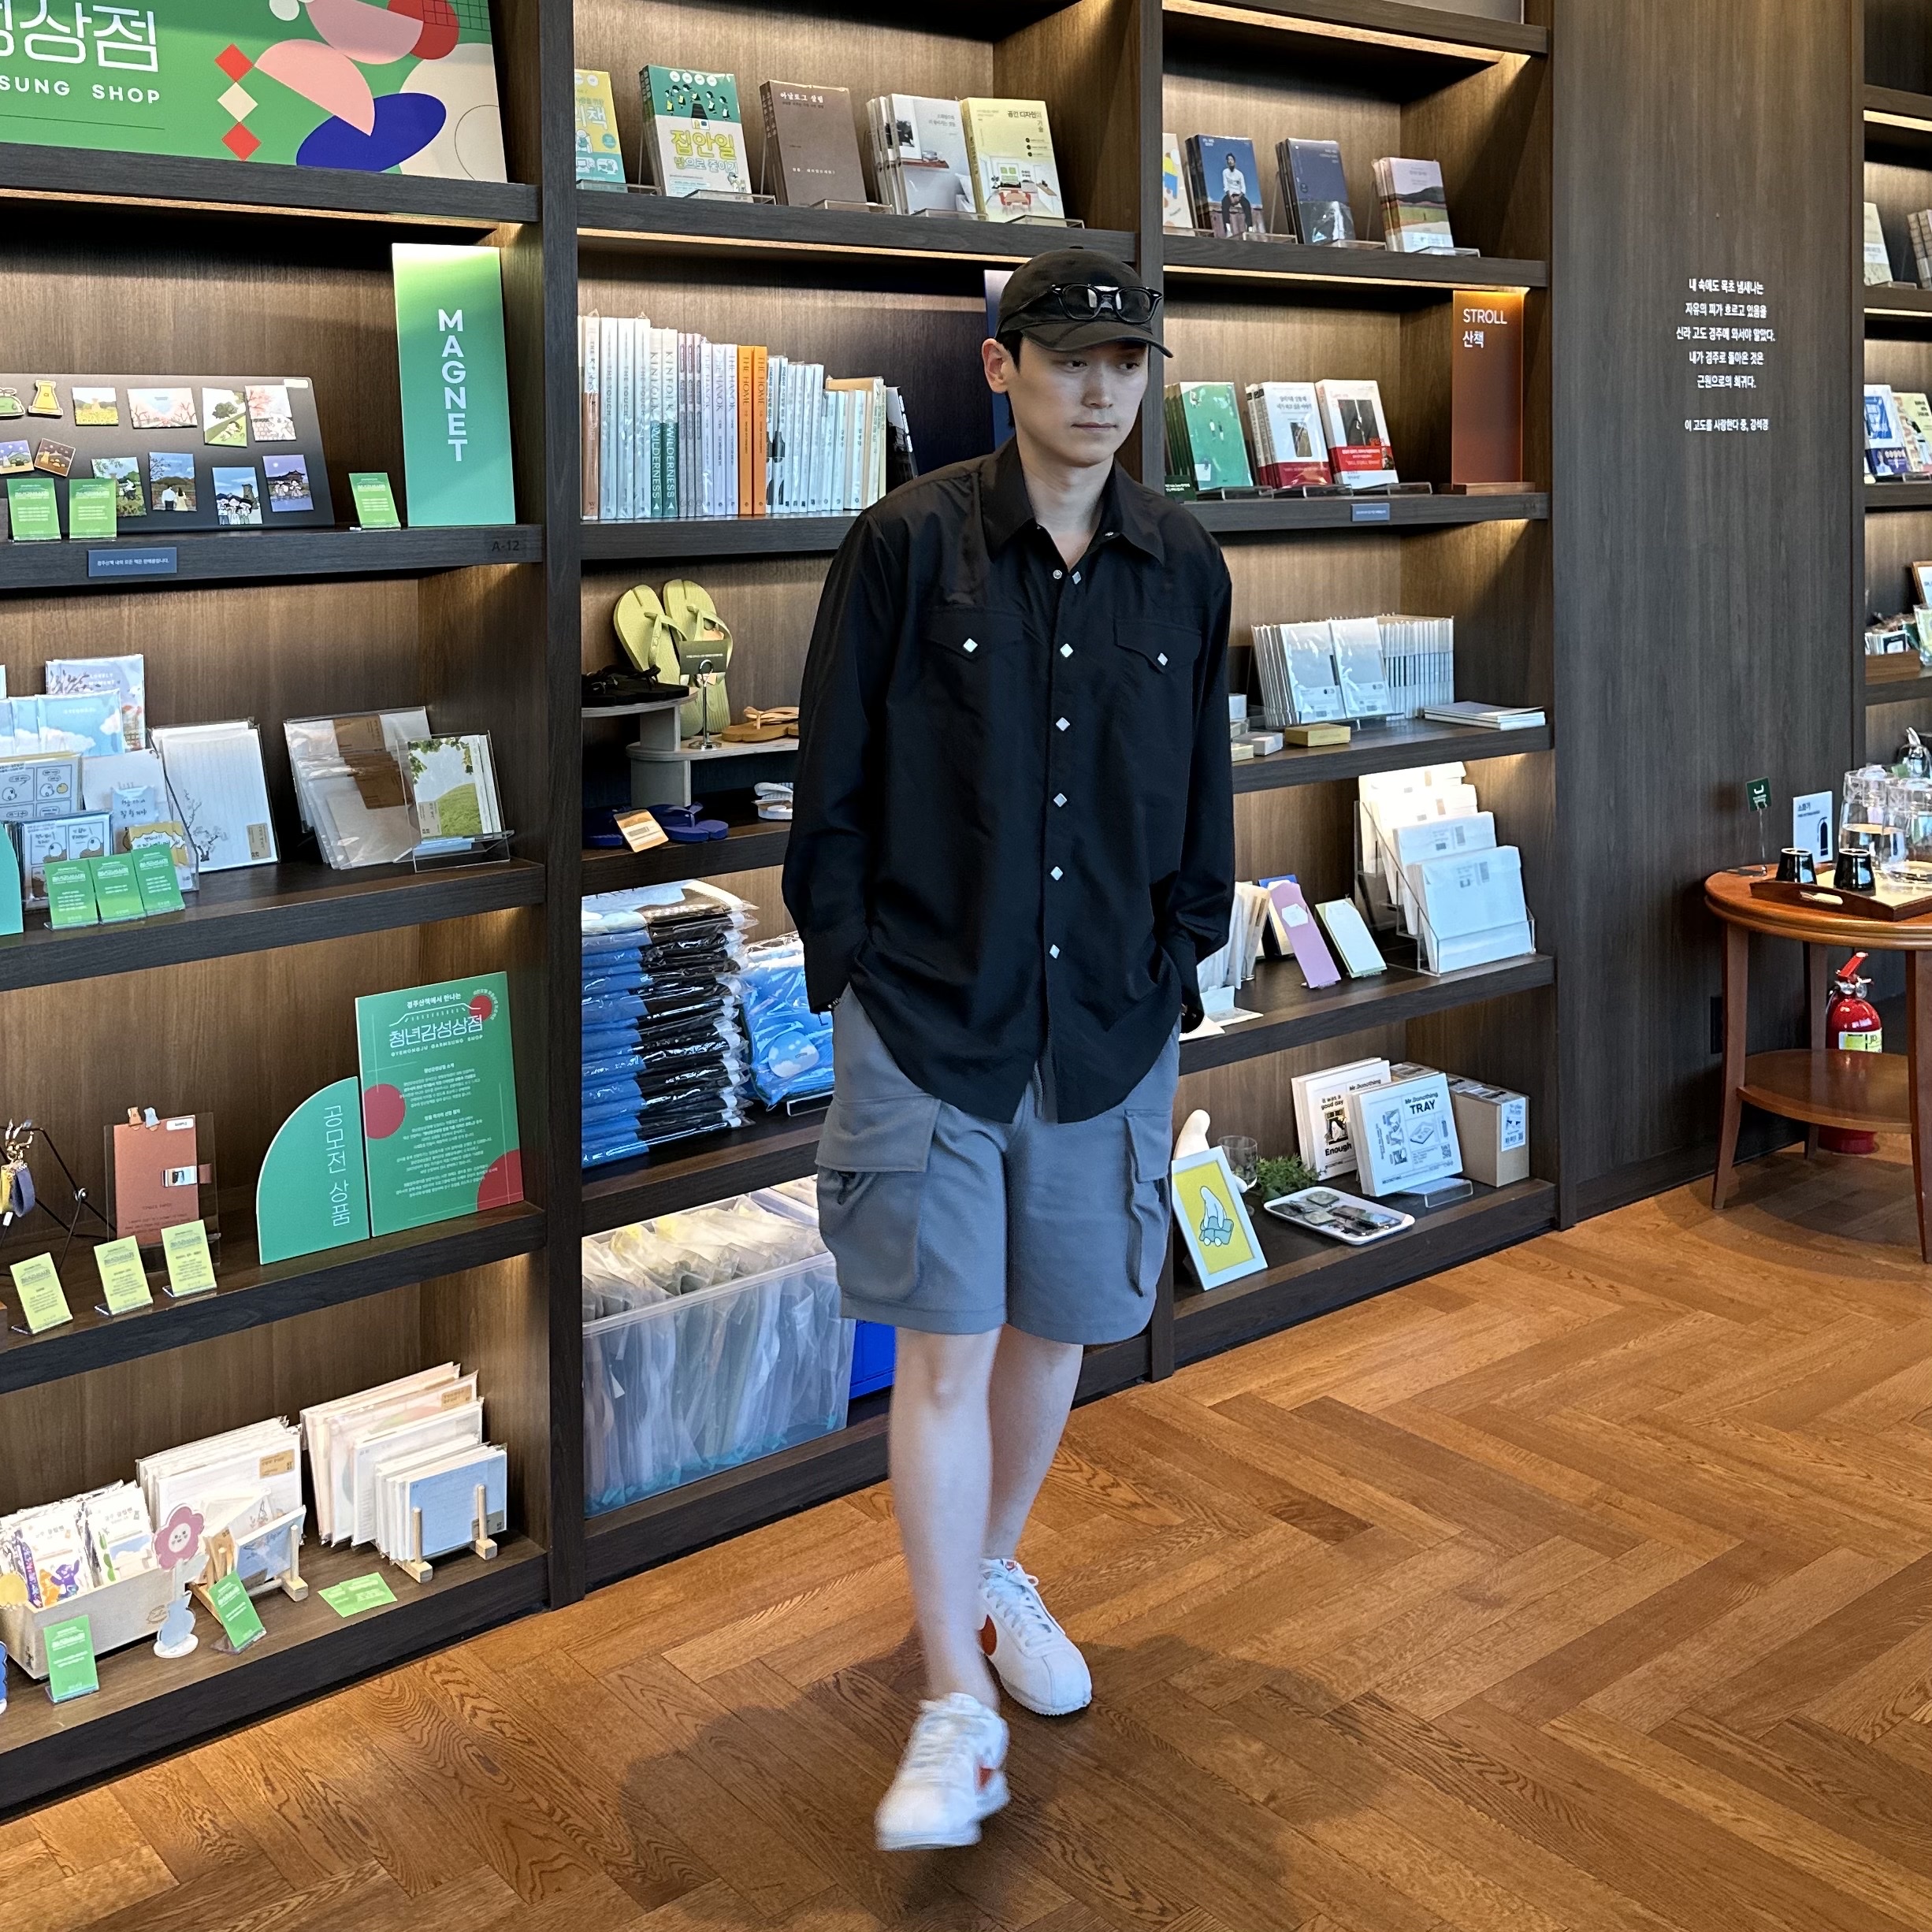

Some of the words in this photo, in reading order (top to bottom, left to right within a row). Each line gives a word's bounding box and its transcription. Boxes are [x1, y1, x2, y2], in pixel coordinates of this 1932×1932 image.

[0, 0, 158, 72] 상점
[91, 84, 160, 104] SHOP
[670, 129, 737, 161] 집안일
[674, 156, 707, 170] 반으로
[708, 160, 739, 175] 줄이기
[1689, 278, 1696, 292] 내
[1698, 278, 1720, 292] 속에도
[1462, 308, 1508, 325] STROLL
[1685, 302, 1707, 316] 자유의
[1708, 303, 1723, 317] 피가
[1724, 303, 1745, 317] 흐르고
[1746, 304, 1767, 319] 있음을
[1462, 330, 1484, 349] 산책
[1676, 326, 1691, 340] 신라
[1692, 327, 1707, 340] 고도
[1708, 327, 1730, 340] 경주에
[1730, 328, 1752, 342] 와서야
[1753, 328, 1776, 342] 알았다.
[1689, 351, 1704, 365] 내가
[1705, 351, 1727, 365] 경주로
[1728, 351, 1749, 366] 돌아온
[1750, 351, 1764, 366] 것은
[437, 308, 468, 463] MAGNET
[1696, 374, 1733, 388] 근원으로의
[1733, 375, 1756, 388] 회귀다.
[1685, 419, 1692, 432] 이
[1693, 419, 1712, 432] 고도를
[1713, 418, 1739, 432] 사랑한다
[652, 424, 661, 499] WILDERNESS
[667, 423, 675, 498] WILDERNESS
[492, 541, 520, 552] A-12
[1797, 802, 1811, 812] 소화기
[407, 994, 443, 1009] 경주산책에서
[388, 1014, 483, 1049] 청년감성상점
[1409, 1099, 1436, 1115] TRAY
[323, 1105, 347, 1174] 공모전
[1325, 1142, 1352, 1157] Enough
[329, 1180, 351, 1227] 상품
